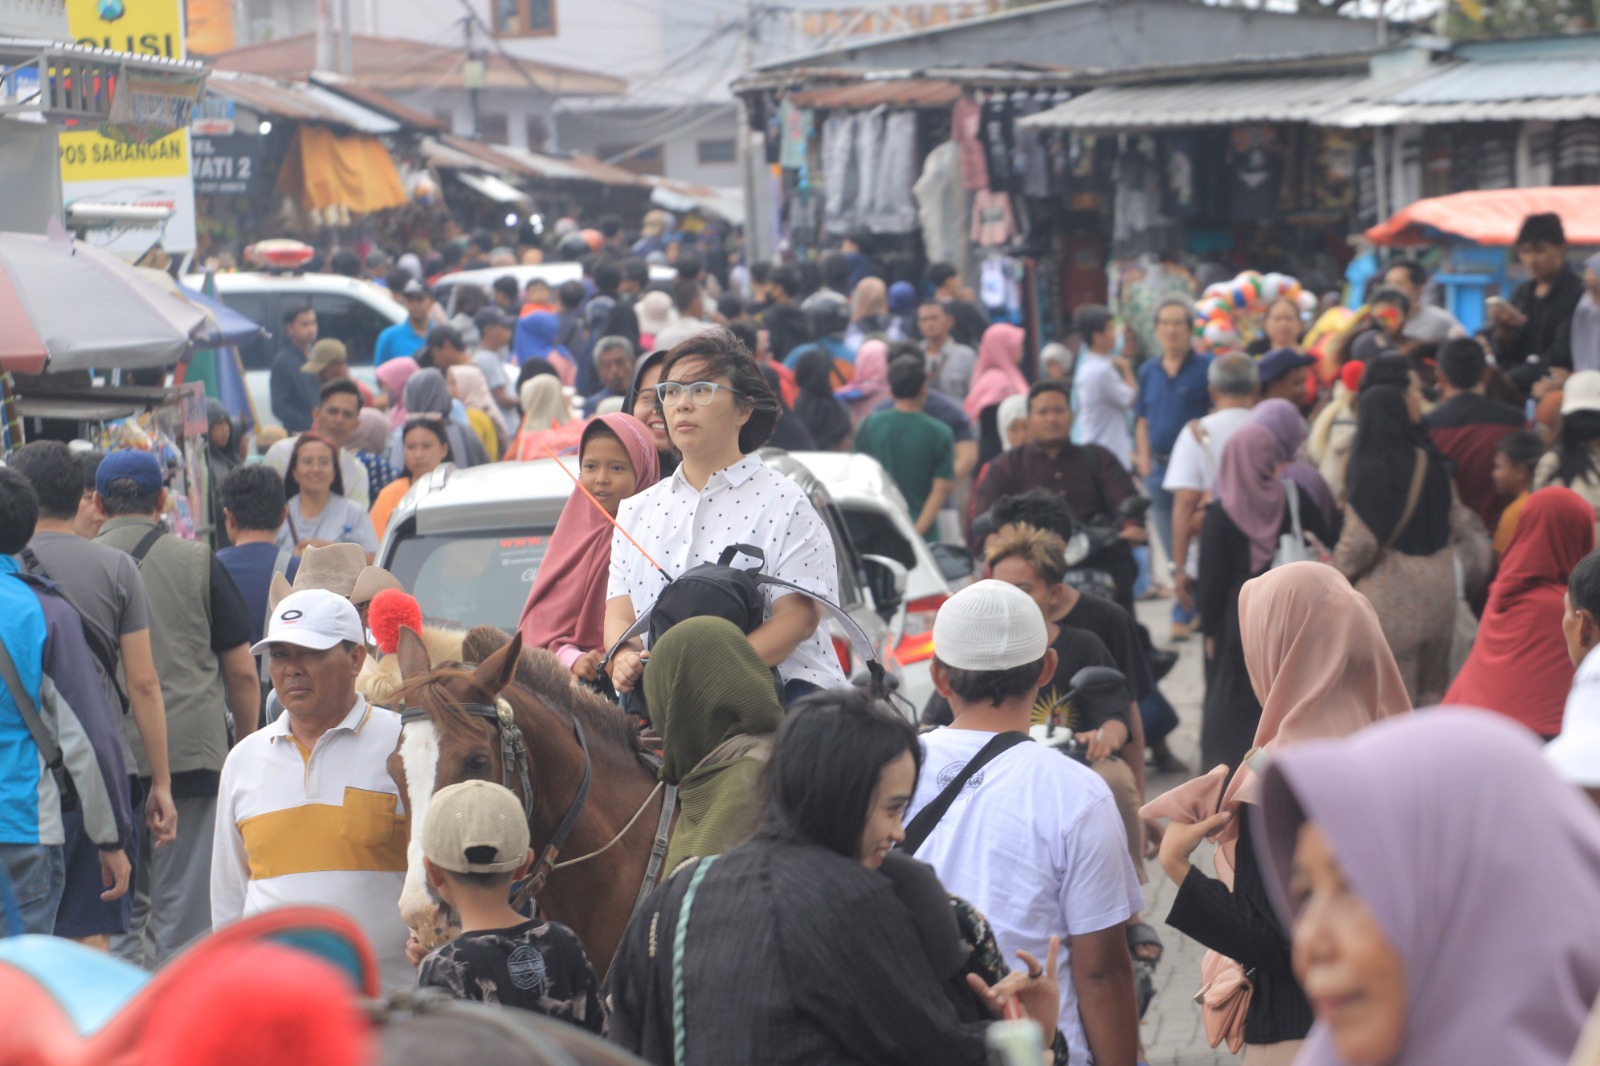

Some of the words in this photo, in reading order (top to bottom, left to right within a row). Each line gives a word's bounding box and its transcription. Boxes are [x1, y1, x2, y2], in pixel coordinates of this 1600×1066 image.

[92, 140, 181, 164] SARANGAN
[237, 156, 252, 178] 2
[500, 536, 552, 548] www.
